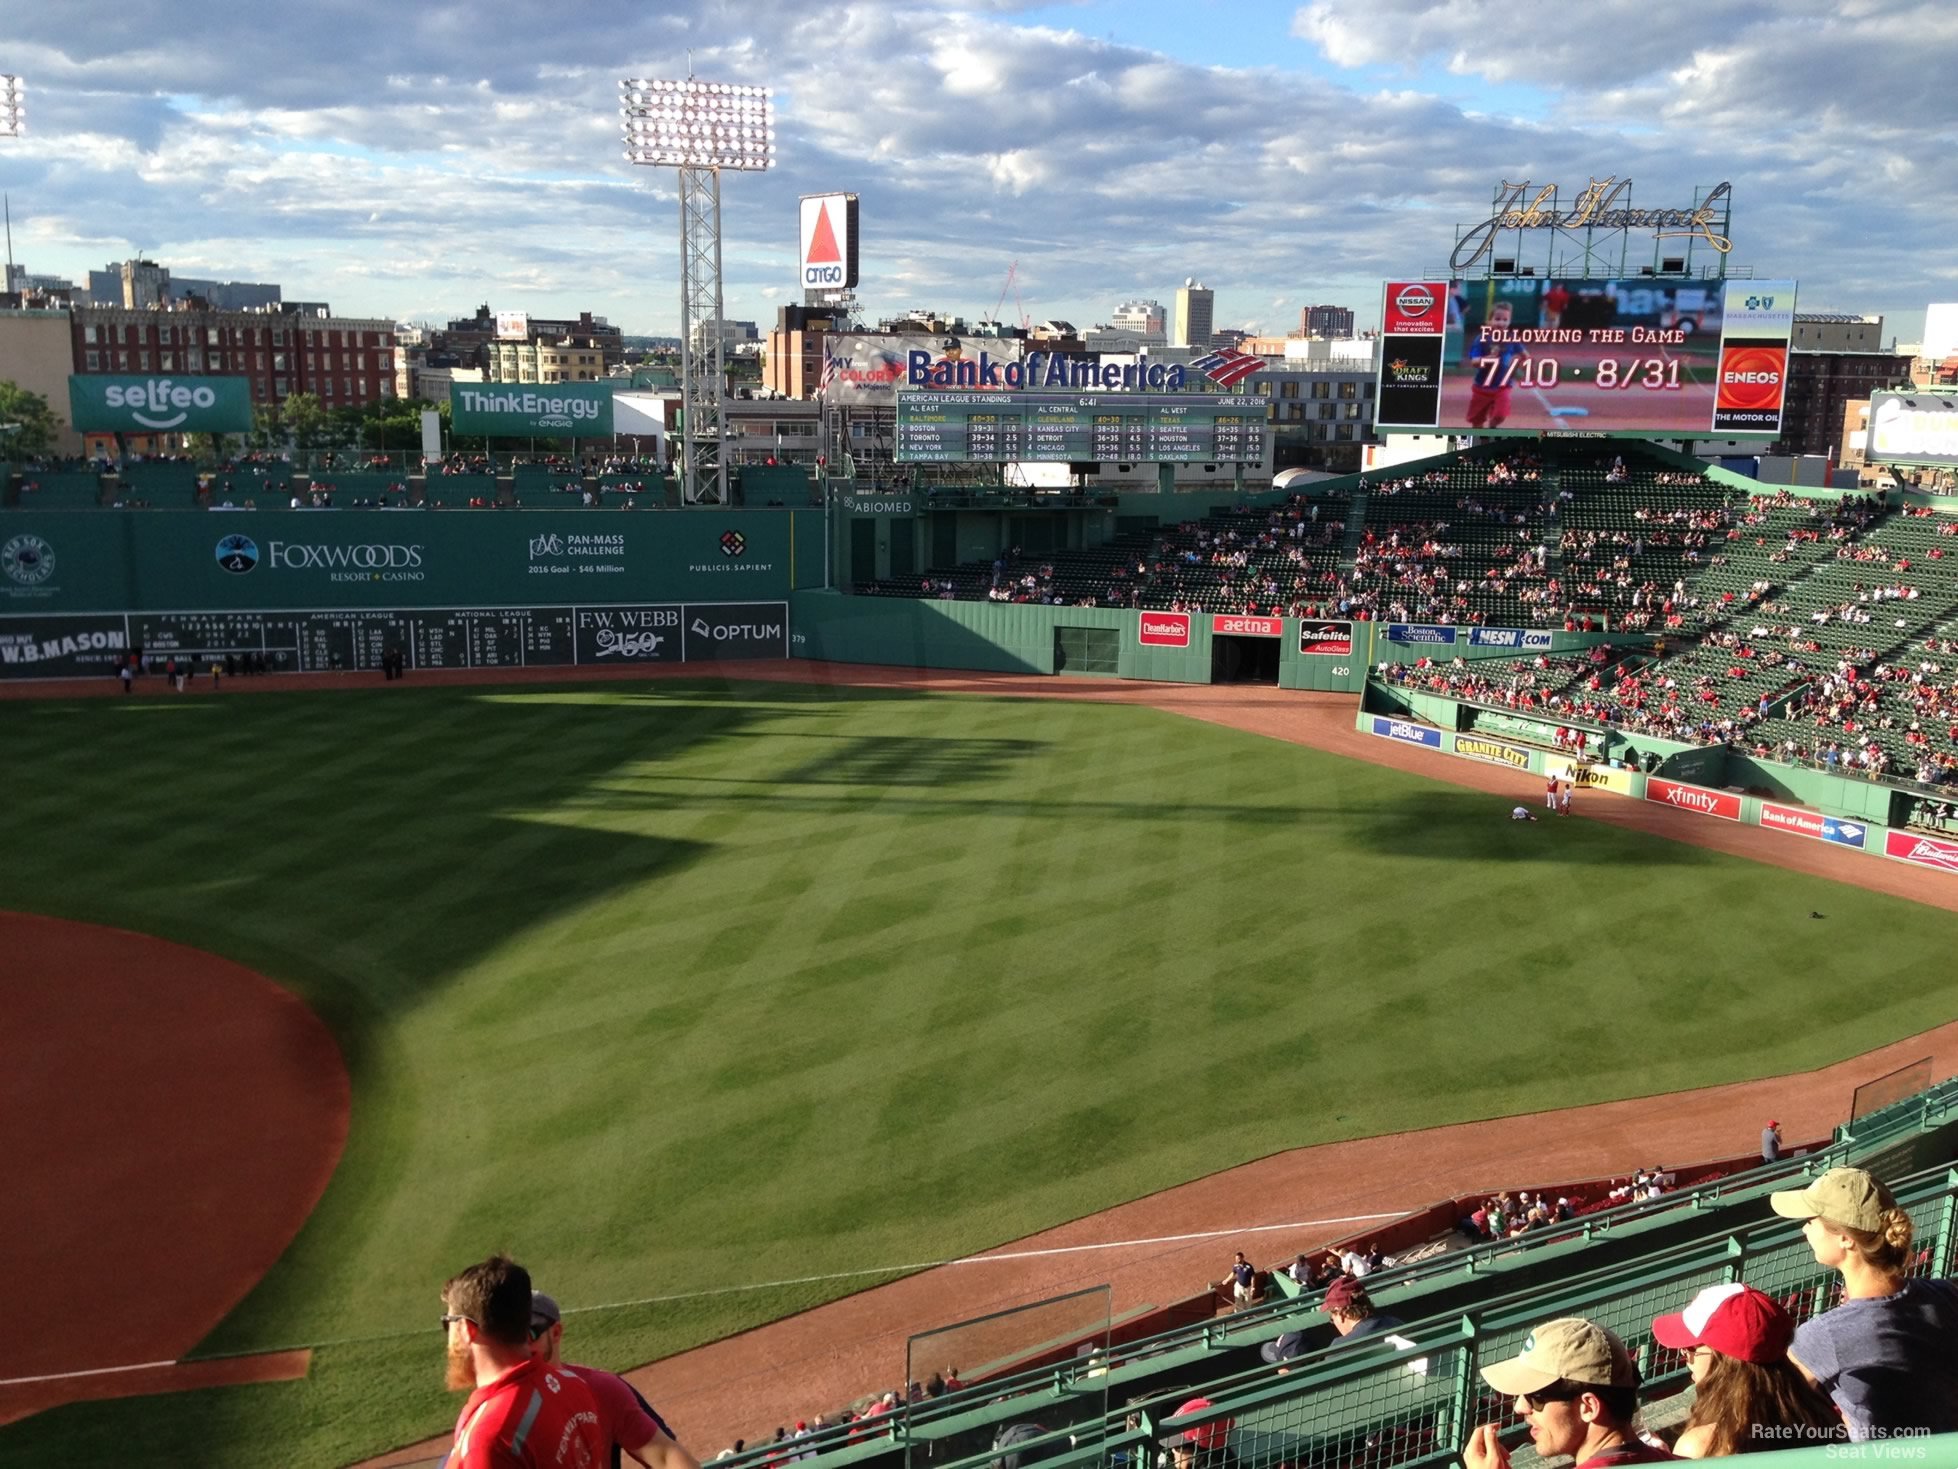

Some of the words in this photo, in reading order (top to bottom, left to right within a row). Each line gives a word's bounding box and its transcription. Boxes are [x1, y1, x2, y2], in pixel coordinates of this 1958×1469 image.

[1450, 179, 1561, 271] John
[1562, 173, 1733, 252] Hancock
[806, 267, 841, 283] CITGO
[1480, 326, 1582, 343] FOLLOWING
[1589, 330, 1624, 343] THE
[1632, 326, 1684, 343] GAME
[833, 357, 853, 368] MY
[907, 350, 1000, 386] Bank
[1003, 350, 1040, 387] of
[1044, 351, 1186, 387] America
[839, 370, 894, 381] COLORS
[1480, 358, 1558, 387] 7/10
[1596, 359, 1680, 389] 8/31
[1724, 372, 1779, 384] ENEOS
[105, 378, 216, 412] selfeo
[1080, 398, 1096, 406] 6:41
[460, 391, 599, 419] ThinkEnergy
[855, 503, 911, 512] ABIOMED
[567, 535, 624, 544] PAN-MASS
[4, 540, 20, 558] RED
[24, 537, 44, 549] SOX
[268, 541, 422, 568] FOXWOODS
[567, 546, 624, 555] CHALLENGE
[8, 554, 52, 581] SCHOLARS
[579, 565, 594, 573] $46
[689, 564, 773, 572] PUBLICIS.SAPIENT
[330, 572, 371, 582] RESORT
[382, 572, 425, 581] CASINO
[579, 613, 614, 628] F.W.
[620, 611, 679, 627] WEBB
[1223, 618, 1271, 633] aetna
[713, 625, 781, 640] OPTUM
[1301, 630, 1350, 641] Safelite
[1401, 632, 1445, 642] Scientific
[1408, 626, 1436, 634] Boston
[1479, 630, 1517, 645] NESN
[791, 634, 806, 644] 379
[1315, 645, 1349, 653] AutoGlass
[1331, 667, 1350, 676] 420
[1388, 722, 1425, 741] jetBlue
[1456, 739, 1501, 757] GRANITE
[1504, 747, 1527, 766] CITY
[1565, 763, 1609, 785] Nikon
[1667, 786, 1718, 812] xfinity
[1762, 809, 1786, 823] Bank
[1786, 816, 1797, 826] of
[1796, 818, 1835, 835] America
